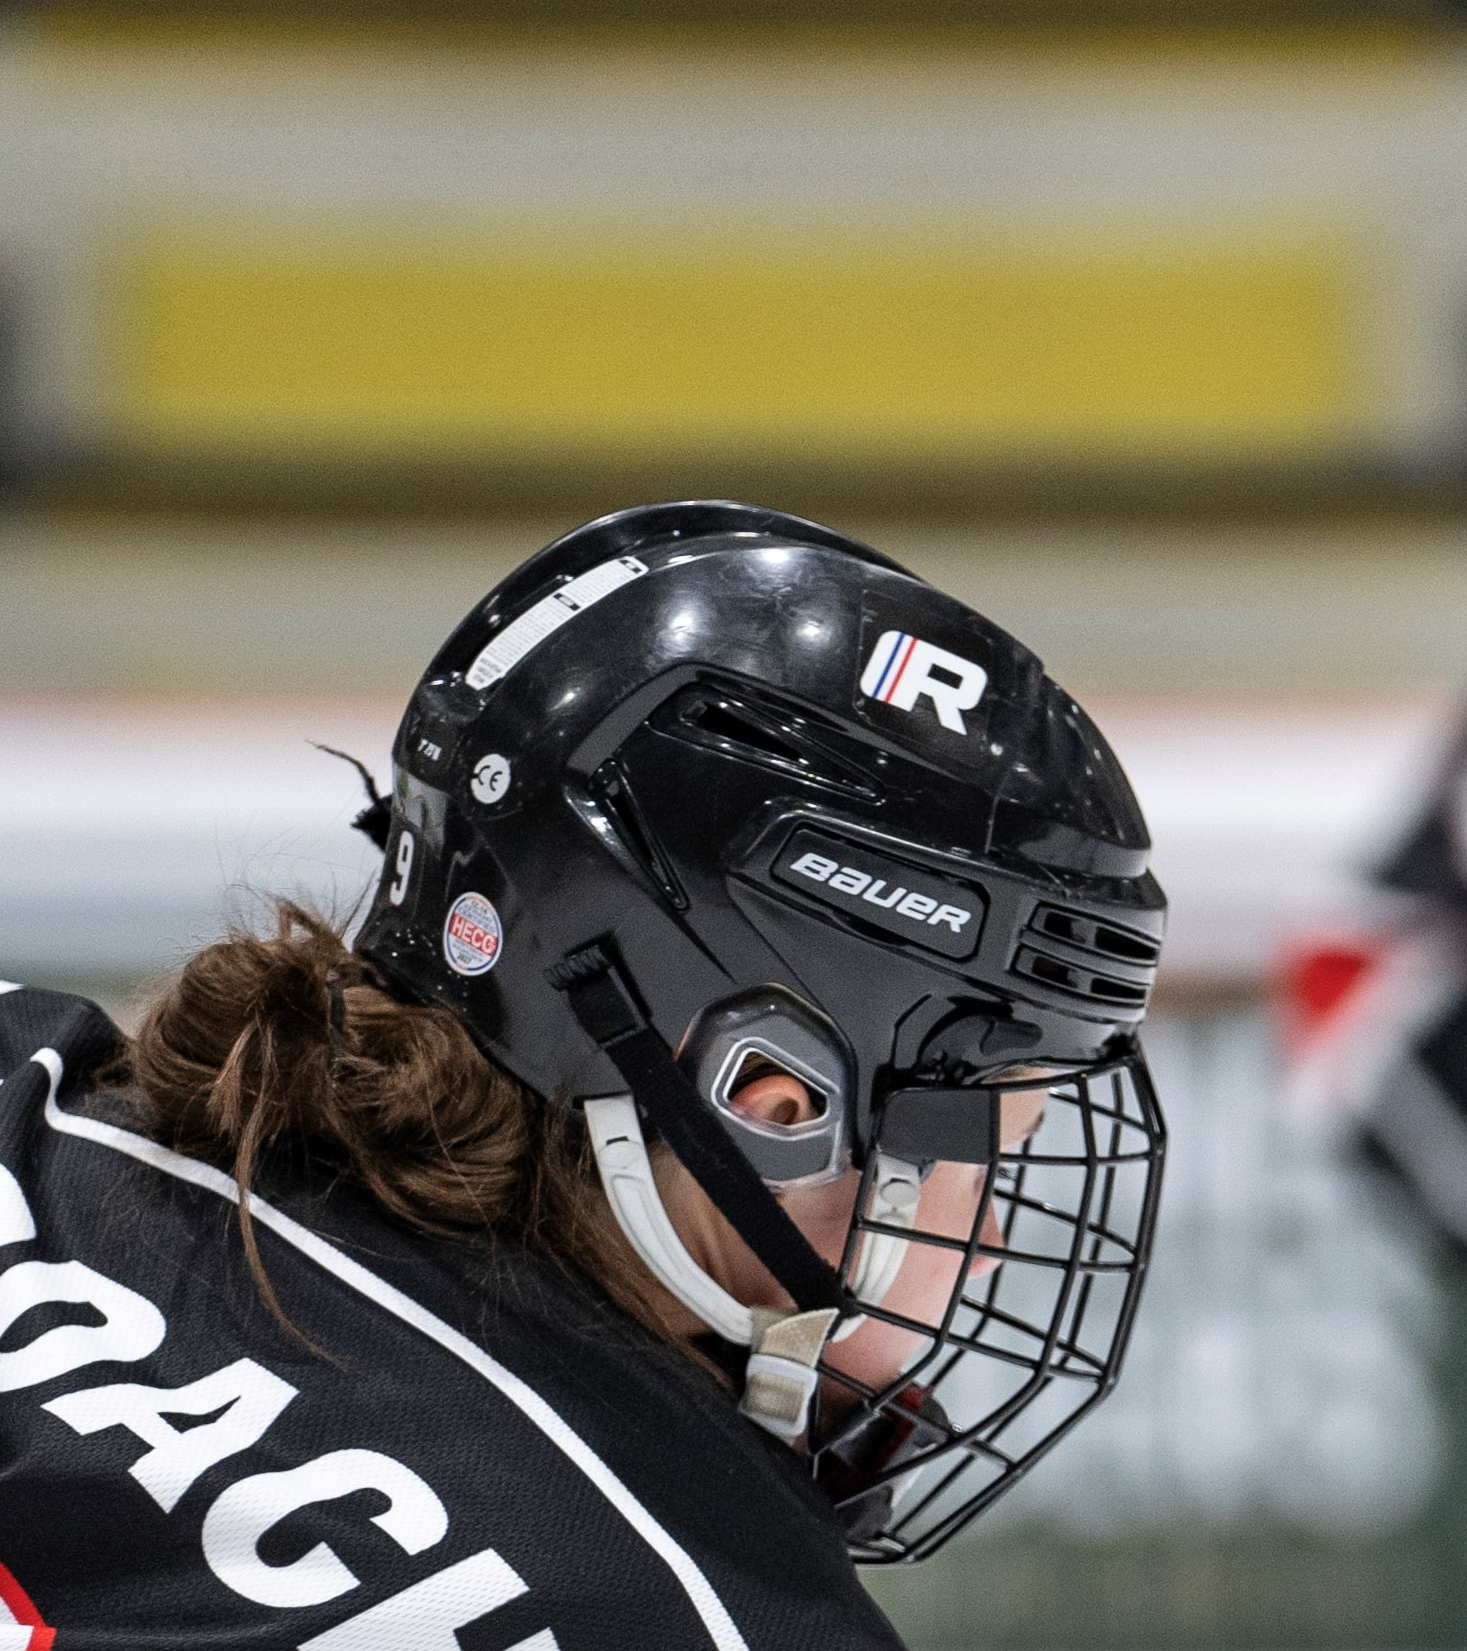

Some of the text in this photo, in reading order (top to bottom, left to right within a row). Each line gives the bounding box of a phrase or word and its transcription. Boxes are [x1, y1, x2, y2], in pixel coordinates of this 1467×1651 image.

[860, 630, 988, 736] R
[477, 764, 503, 792] CE
[390, 830, 414, 906] 9
[789, 852, 972, 933] BAUER
